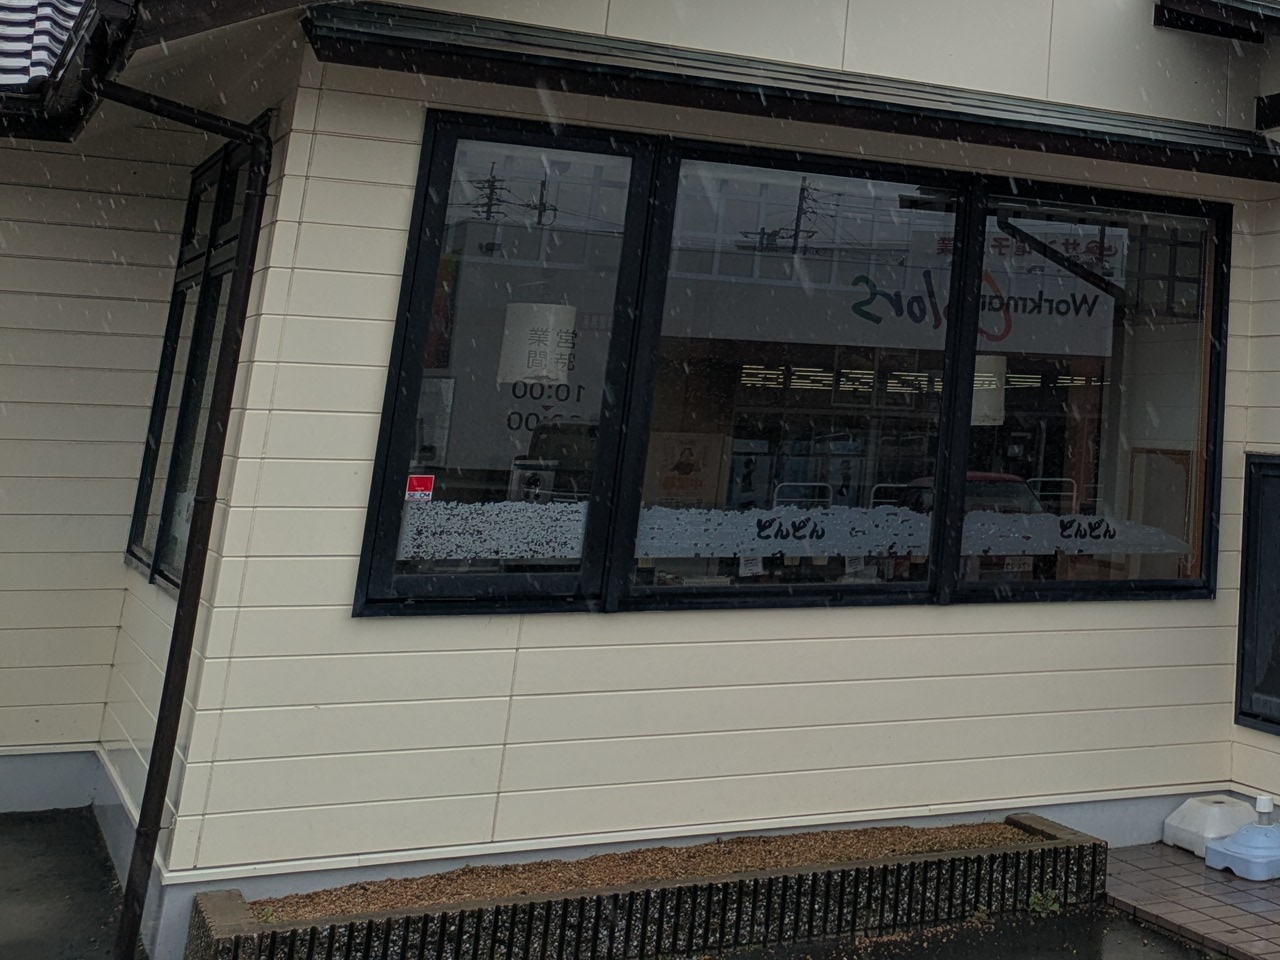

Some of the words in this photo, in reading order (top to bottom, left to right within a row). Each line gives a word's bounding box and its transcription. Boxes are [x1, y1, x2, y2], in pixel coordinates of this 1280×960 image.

[756, 517, 826, 541] どんどん
[1059, 518, 1117, 540] どんどん
